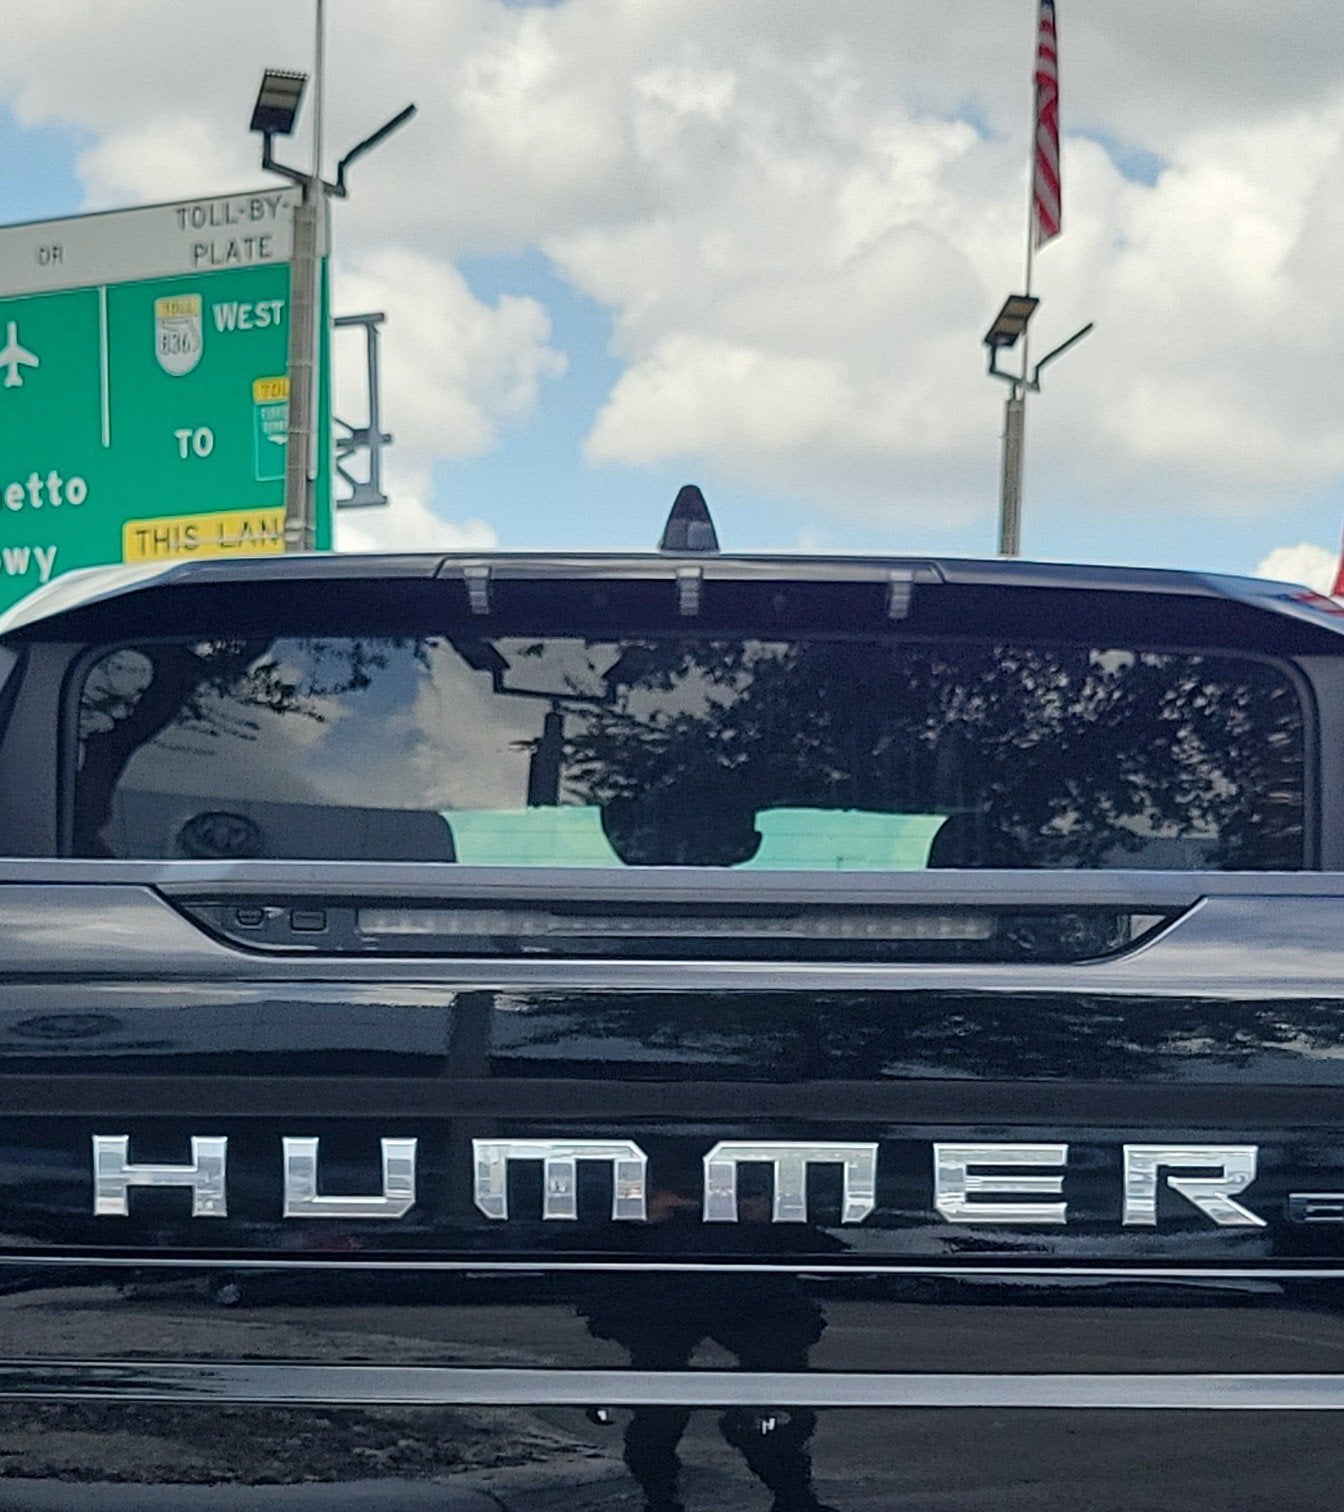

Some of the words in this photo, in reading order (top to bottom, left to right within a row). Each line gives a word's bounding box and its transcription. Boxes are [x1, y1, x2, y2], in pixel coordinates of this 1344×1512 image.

[38, 246, 64, 267] OR
[193, 235, 273, 267] PLATE
[211, 300, 285, 333] WEST
[174, 427, 214, 459] TO
[135, 524, 200, 555] THIS
[219, 518, 281, 548] LAN
[92, 1134, 1268, 1226] HUMMER
